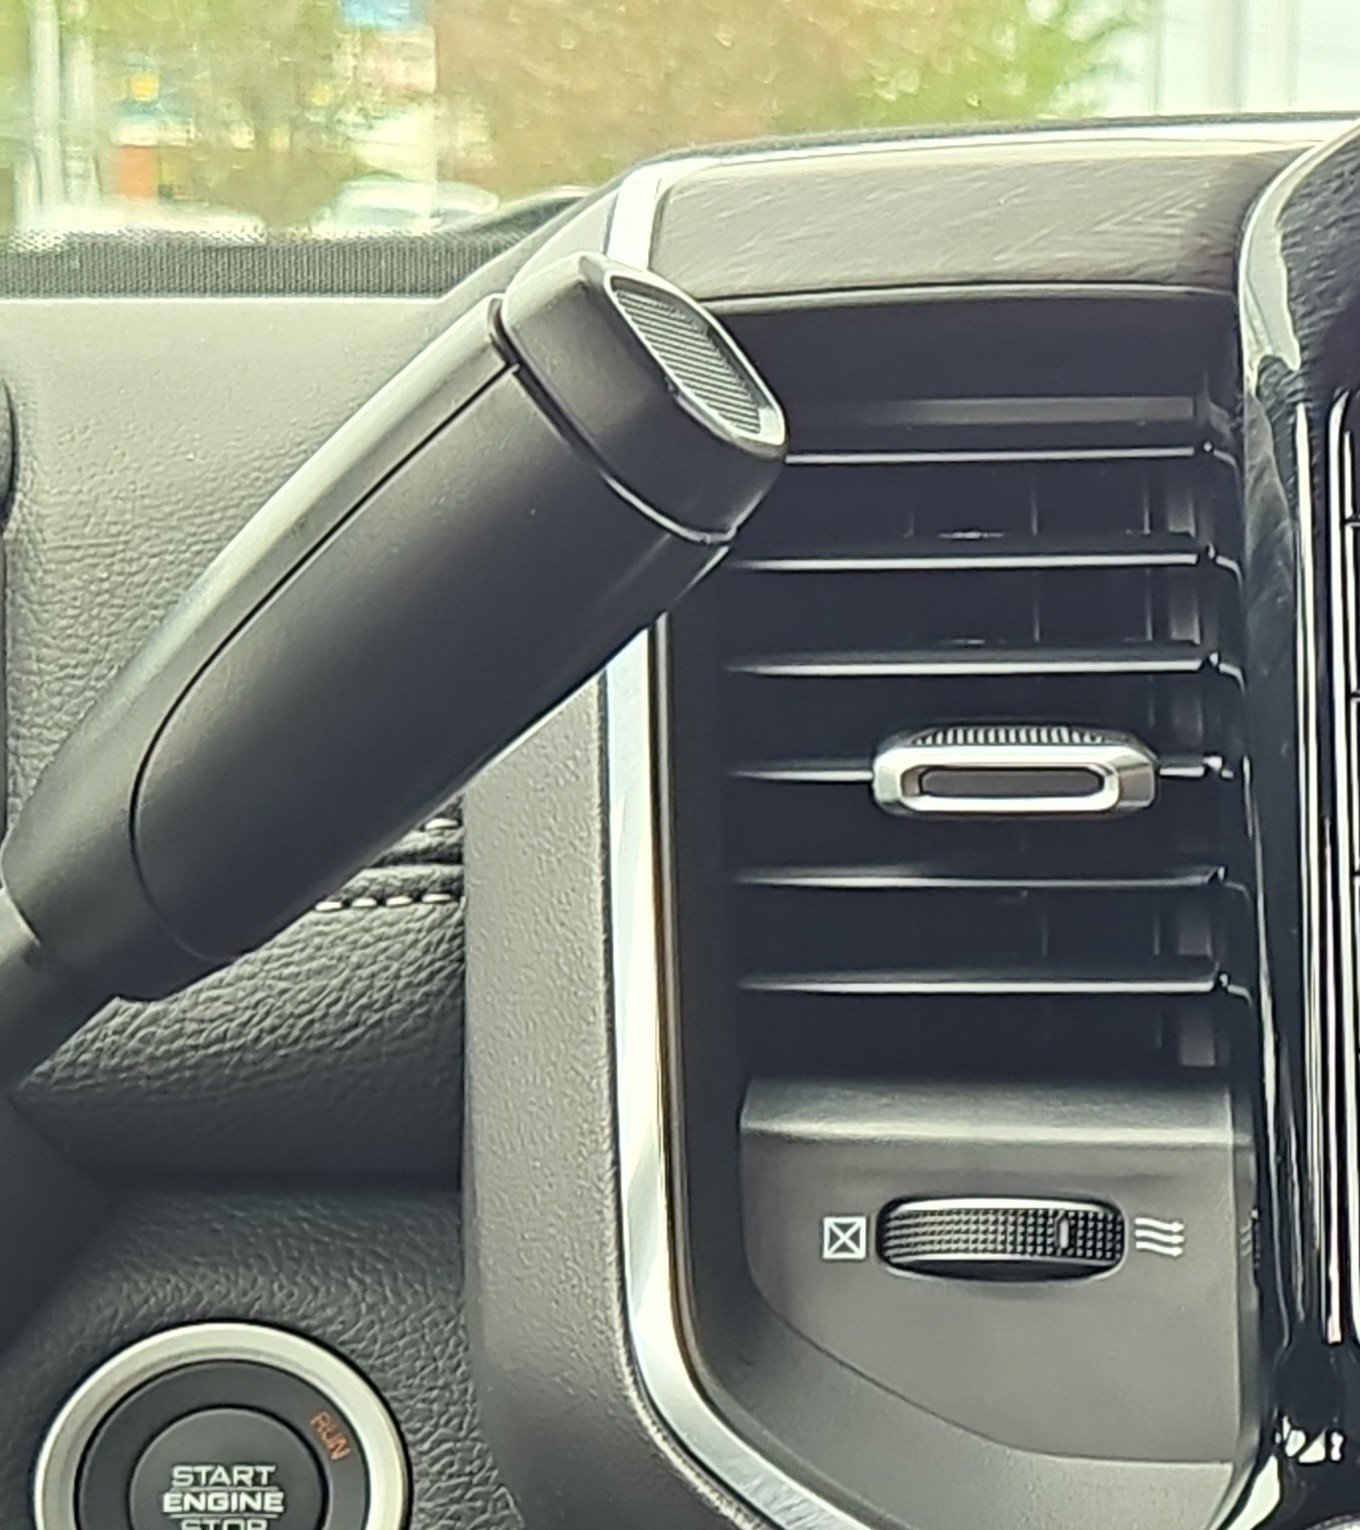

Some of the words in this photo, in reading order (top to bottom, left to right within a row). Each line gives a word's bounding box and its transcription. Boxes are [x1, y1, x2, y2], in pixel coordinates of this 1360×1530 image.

[310, 1411, 351, 1462] RUN
[171, 1464, 276, 1486] START
[161, 1492, 285, 1513] ENGINE
